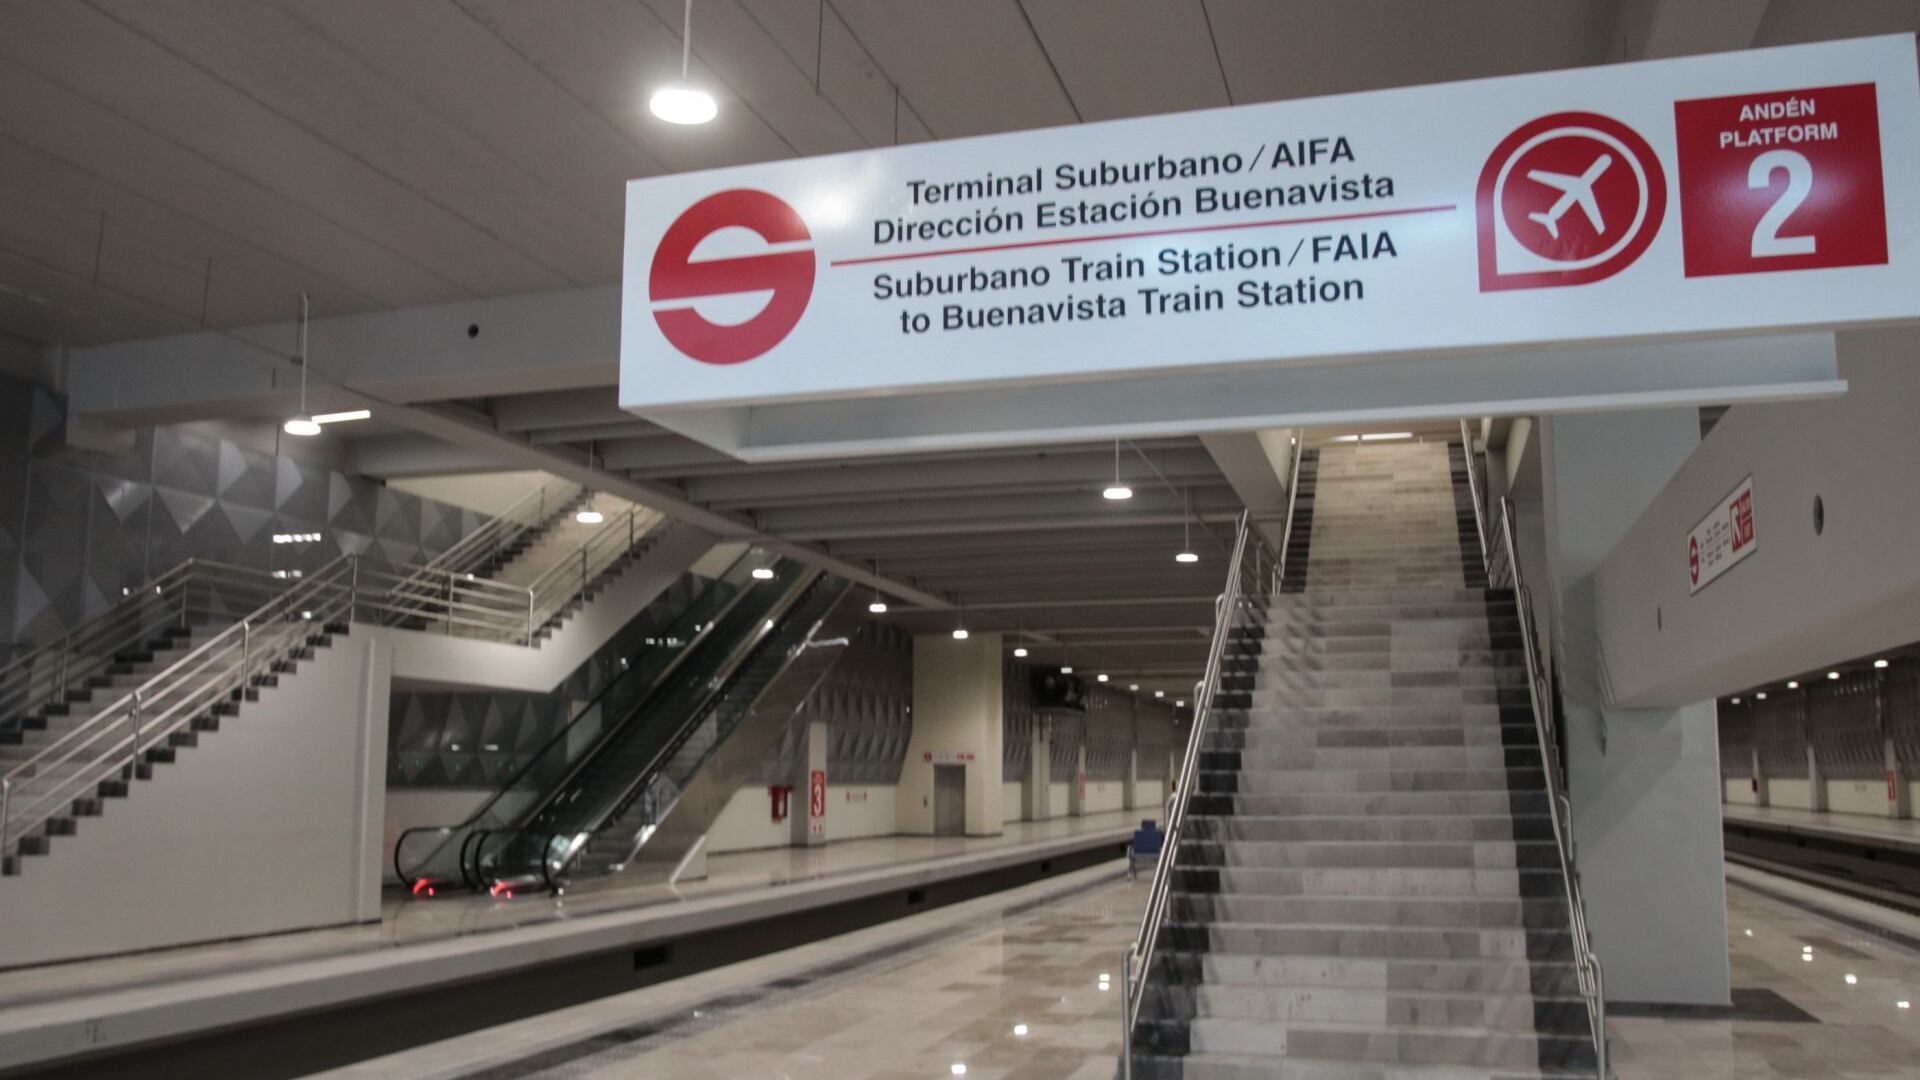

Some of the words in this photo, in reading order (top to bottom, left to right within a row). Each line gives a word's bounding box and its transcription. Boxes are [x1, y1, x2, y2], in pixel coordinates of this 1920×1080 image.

[1739, 96, 1816, 121] ANDÉN
[1720, 122, 1839, 148] PLATFORM
[874, 206, 1024, 244] Dirección
[1037, 191, 1182, 228] Estación
[1195, 173, 1395, 214] Buenavista
[907, 167, 1042, 205] Terminal
[1747, 149, 1816, 258] 2
[873, 265, 1050, 300] Suburbano
[1061, 253, 1145, 283] Train
[900, 309, 930, 334] to
[942, 294, 1126, 331] Buenavista
[1137, 284, 1224, 315] Train
[1237, 275, 1364, 308] Station
